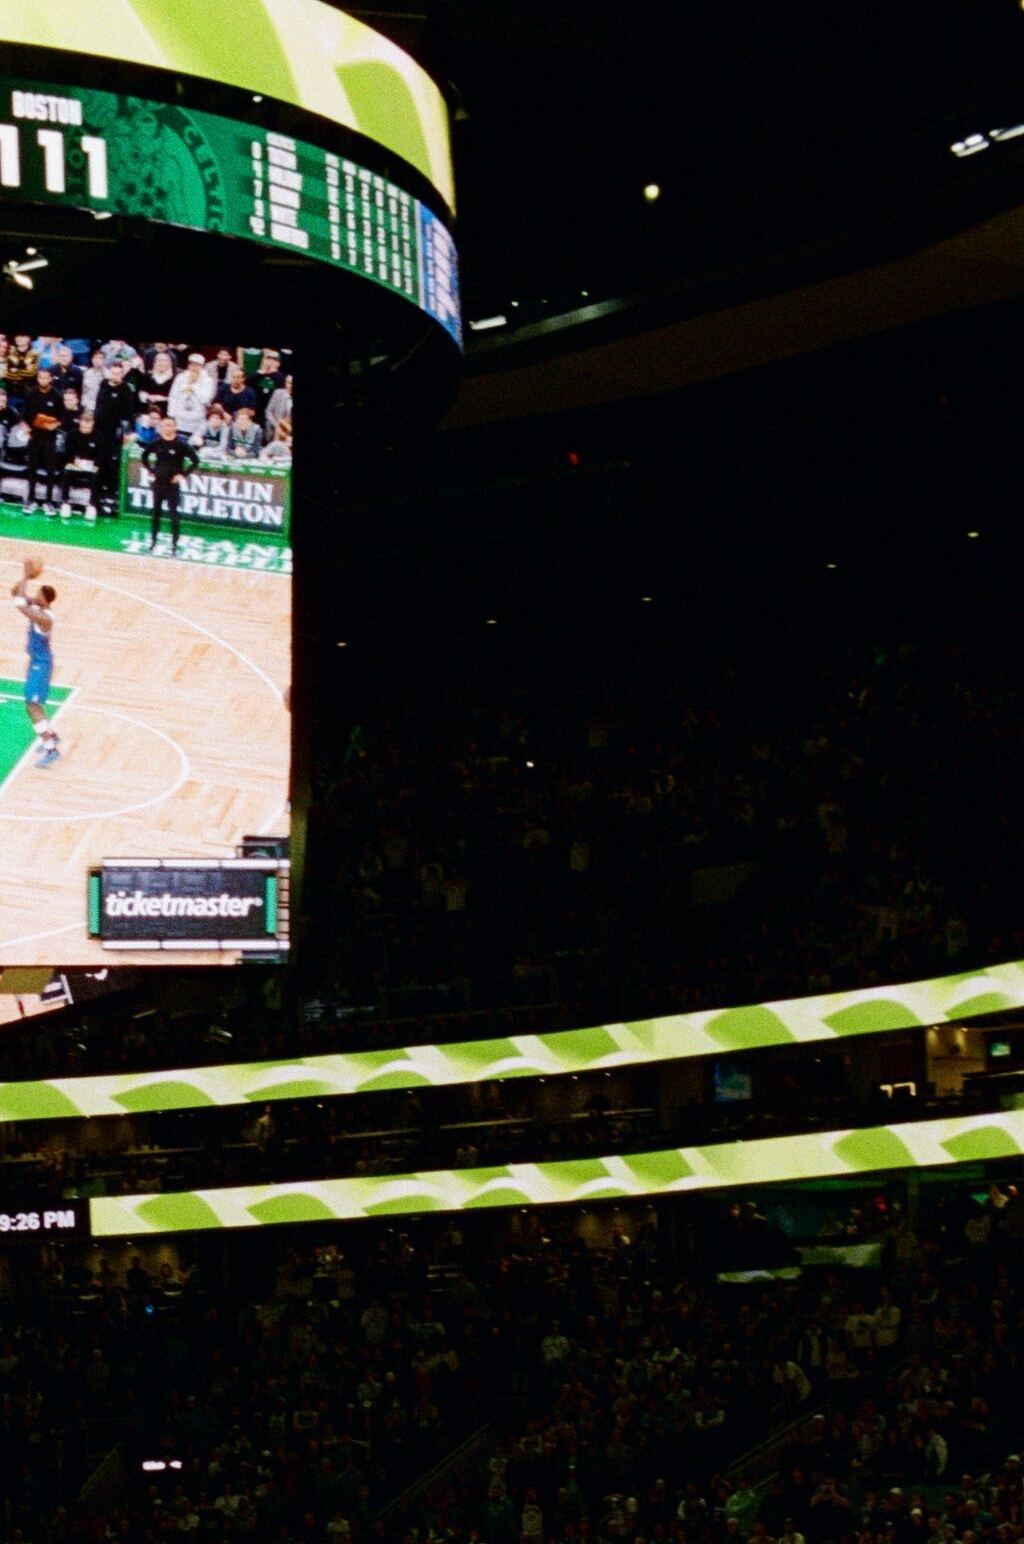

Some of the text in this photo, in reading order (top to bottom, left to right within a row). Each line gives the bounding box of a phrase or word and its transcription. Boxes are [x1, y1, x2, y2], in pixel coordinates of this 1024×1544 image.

[11, 90, 83, 126] BOSTON
[139, 466, 274, 502] FANKLIN
[127, 487, 284, 525] TEPLETON
[105, 891, 256, 918] ticketmaster
[44, 1210, 75, 1229] PM
